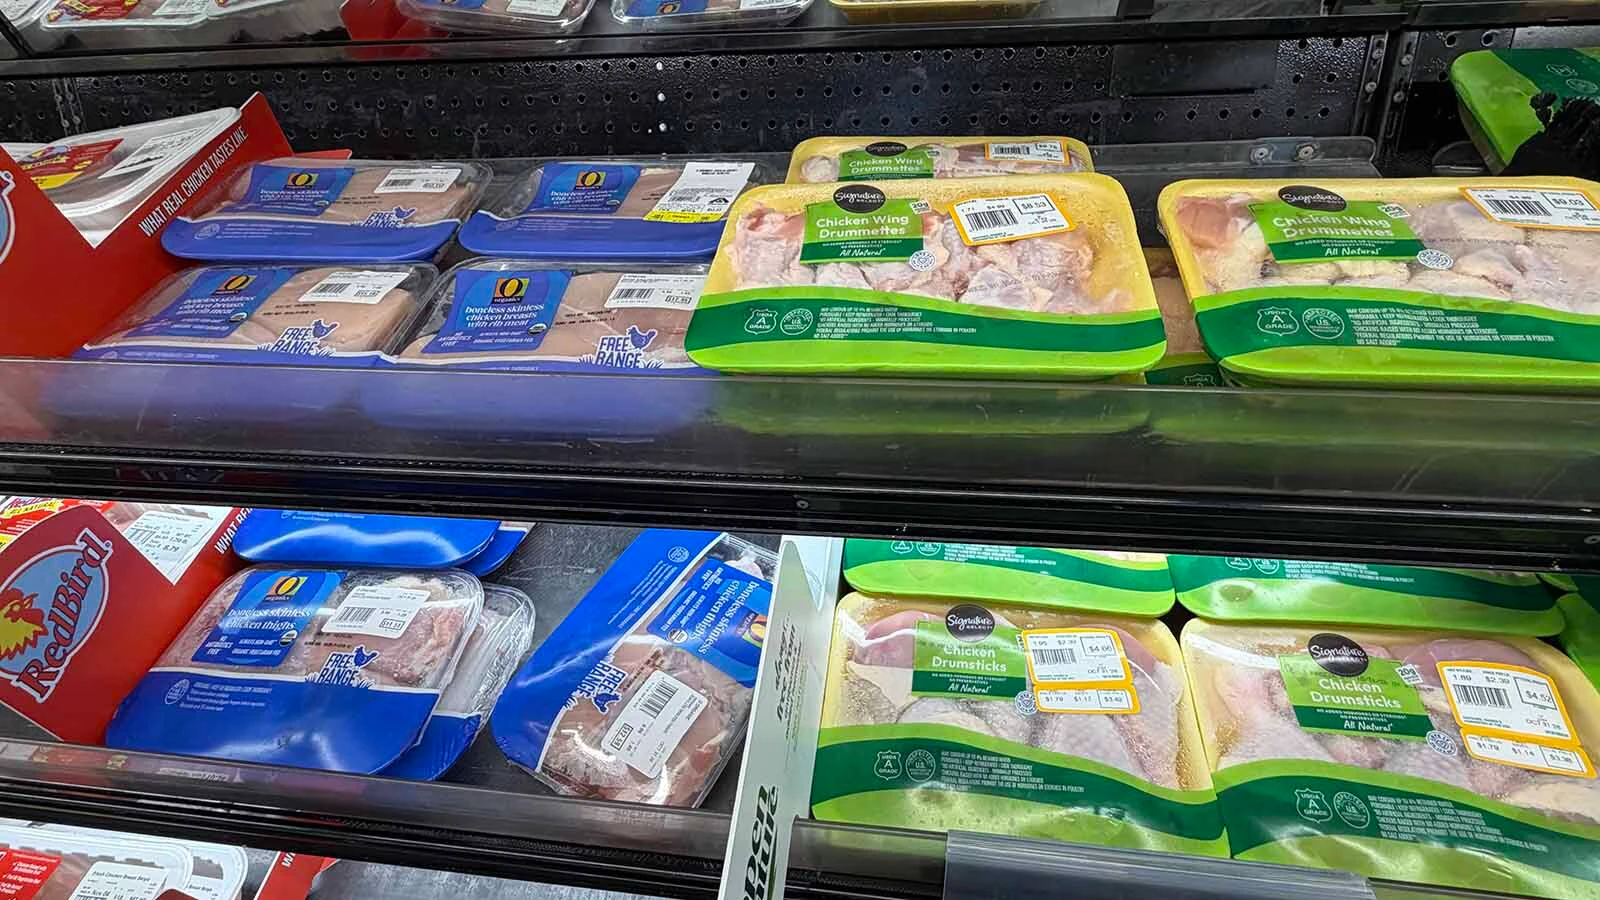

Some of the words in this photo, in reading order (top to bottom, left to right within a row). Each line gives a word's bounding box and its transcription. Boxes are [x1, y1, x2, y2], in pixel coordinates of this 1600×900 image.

[849, 158, 893, 168] Chicken
[894, 157, 924, 166] Wing
[850, 164, 921, 175] Drummettes
[139, 206, 168, 237] WHAT
[162, 190, 187, 215] REAL
[181, 160, 215, 197] CHICKEN
[208, 138, 236, 168] TASTES
[232, 126, 249, 149] LIKE
[835, 192, 885, 204] Signature
[1020, 201, 1048, 211] $8.53
[369, 211, 395, 219] FREE
[816, 216, 869, 228] Chicken
[872, 214, 910, 226] Wing
[1273, 215, 1343, 228] Chicken
[1344, 215, 1392, 229] Wing
[819, 226, 906, 239] Drummettes
[1283, 226, 1395, 239] Drummettes
[840, 249, 850, 257] All
[1324, 247, 1338, 257] All
[465, 305, 506, 314] boneless
[507, 303, 545, 313] skinless
[465, 313, 502, 322] chicken
[503, 311, 537, 321] breasts
[467, 320, 489, 328] with
[489, 319, 504, 327] rib
[504, 318, 528, 327] meat
[756, 316, 767, 325] A
[1271, 314, 1284, 323] A
[281, 327, 313, 341] FREE
[271, 340, 318, 355] RANGE
[600, 336, 630, 352] FREE
[596, 352, 642, 369] RANGE
[213, 520, 239, 555] WHAT
[236, 507, 253, 525] RE
[712, 580, 741, 612] chicken
[725, 580, 760, 618] boneless
[12, 529, 113, 701] RedBird
[226, 619, 261, 629] chicken
[261, 620, 297, 631] thighs
[689, 610, 716, 641] thighs
[946, 614, 994, 631] Signature
[698, 616, 731, 655] skinless
[944, 645, 996, 658] Chicken
[1310, 644, 1365, 661] Signature
[325, 653, 355, 669] FREE
[931, 655, 1008, 673] Drumsticks
[320, 668, 359, 684] RANGE
[776, 692, 789, 724] free
[784, 624, 797, 673] from
[1398, 668, 1417, 677] 20g
[578, 662, 612, 699] RANGE
[607, 668, 627, 693] FREE
[1319, 678, 1382, 693] Chicken
[1485, 675, 1511, 684] $2.39
[948, 683, 959, 692] All
[1310, 691, 1402, 708] Drumsticks
[1525, 690, 1553, 703] $4.52
[1343, 720, 1356, 729] All
[1526, 718, 1542, 726] OCT
[1476, 741, 1500, 751] $1.79
[884, 759, 893, 768] A
[1308, 798, 1320, 809] A
[744, 784, 769, 900] pen
